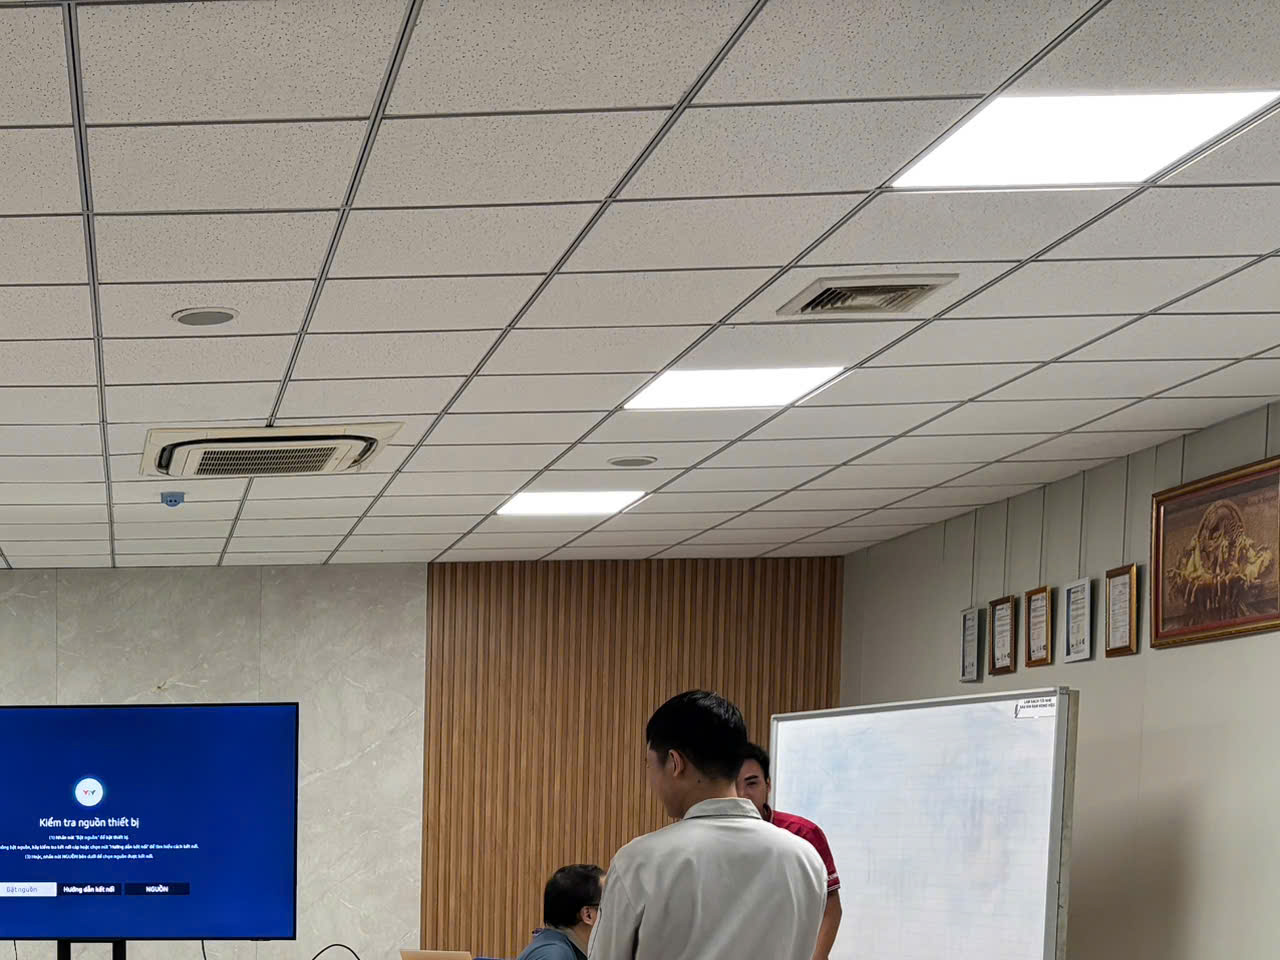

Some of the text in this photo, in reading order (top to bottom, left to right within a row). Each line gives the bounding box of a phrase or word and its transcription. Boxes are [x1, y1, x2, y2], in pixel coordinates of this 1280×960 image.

[39, 816, 140, 829] Kiểm tra nguồn thiết bị
